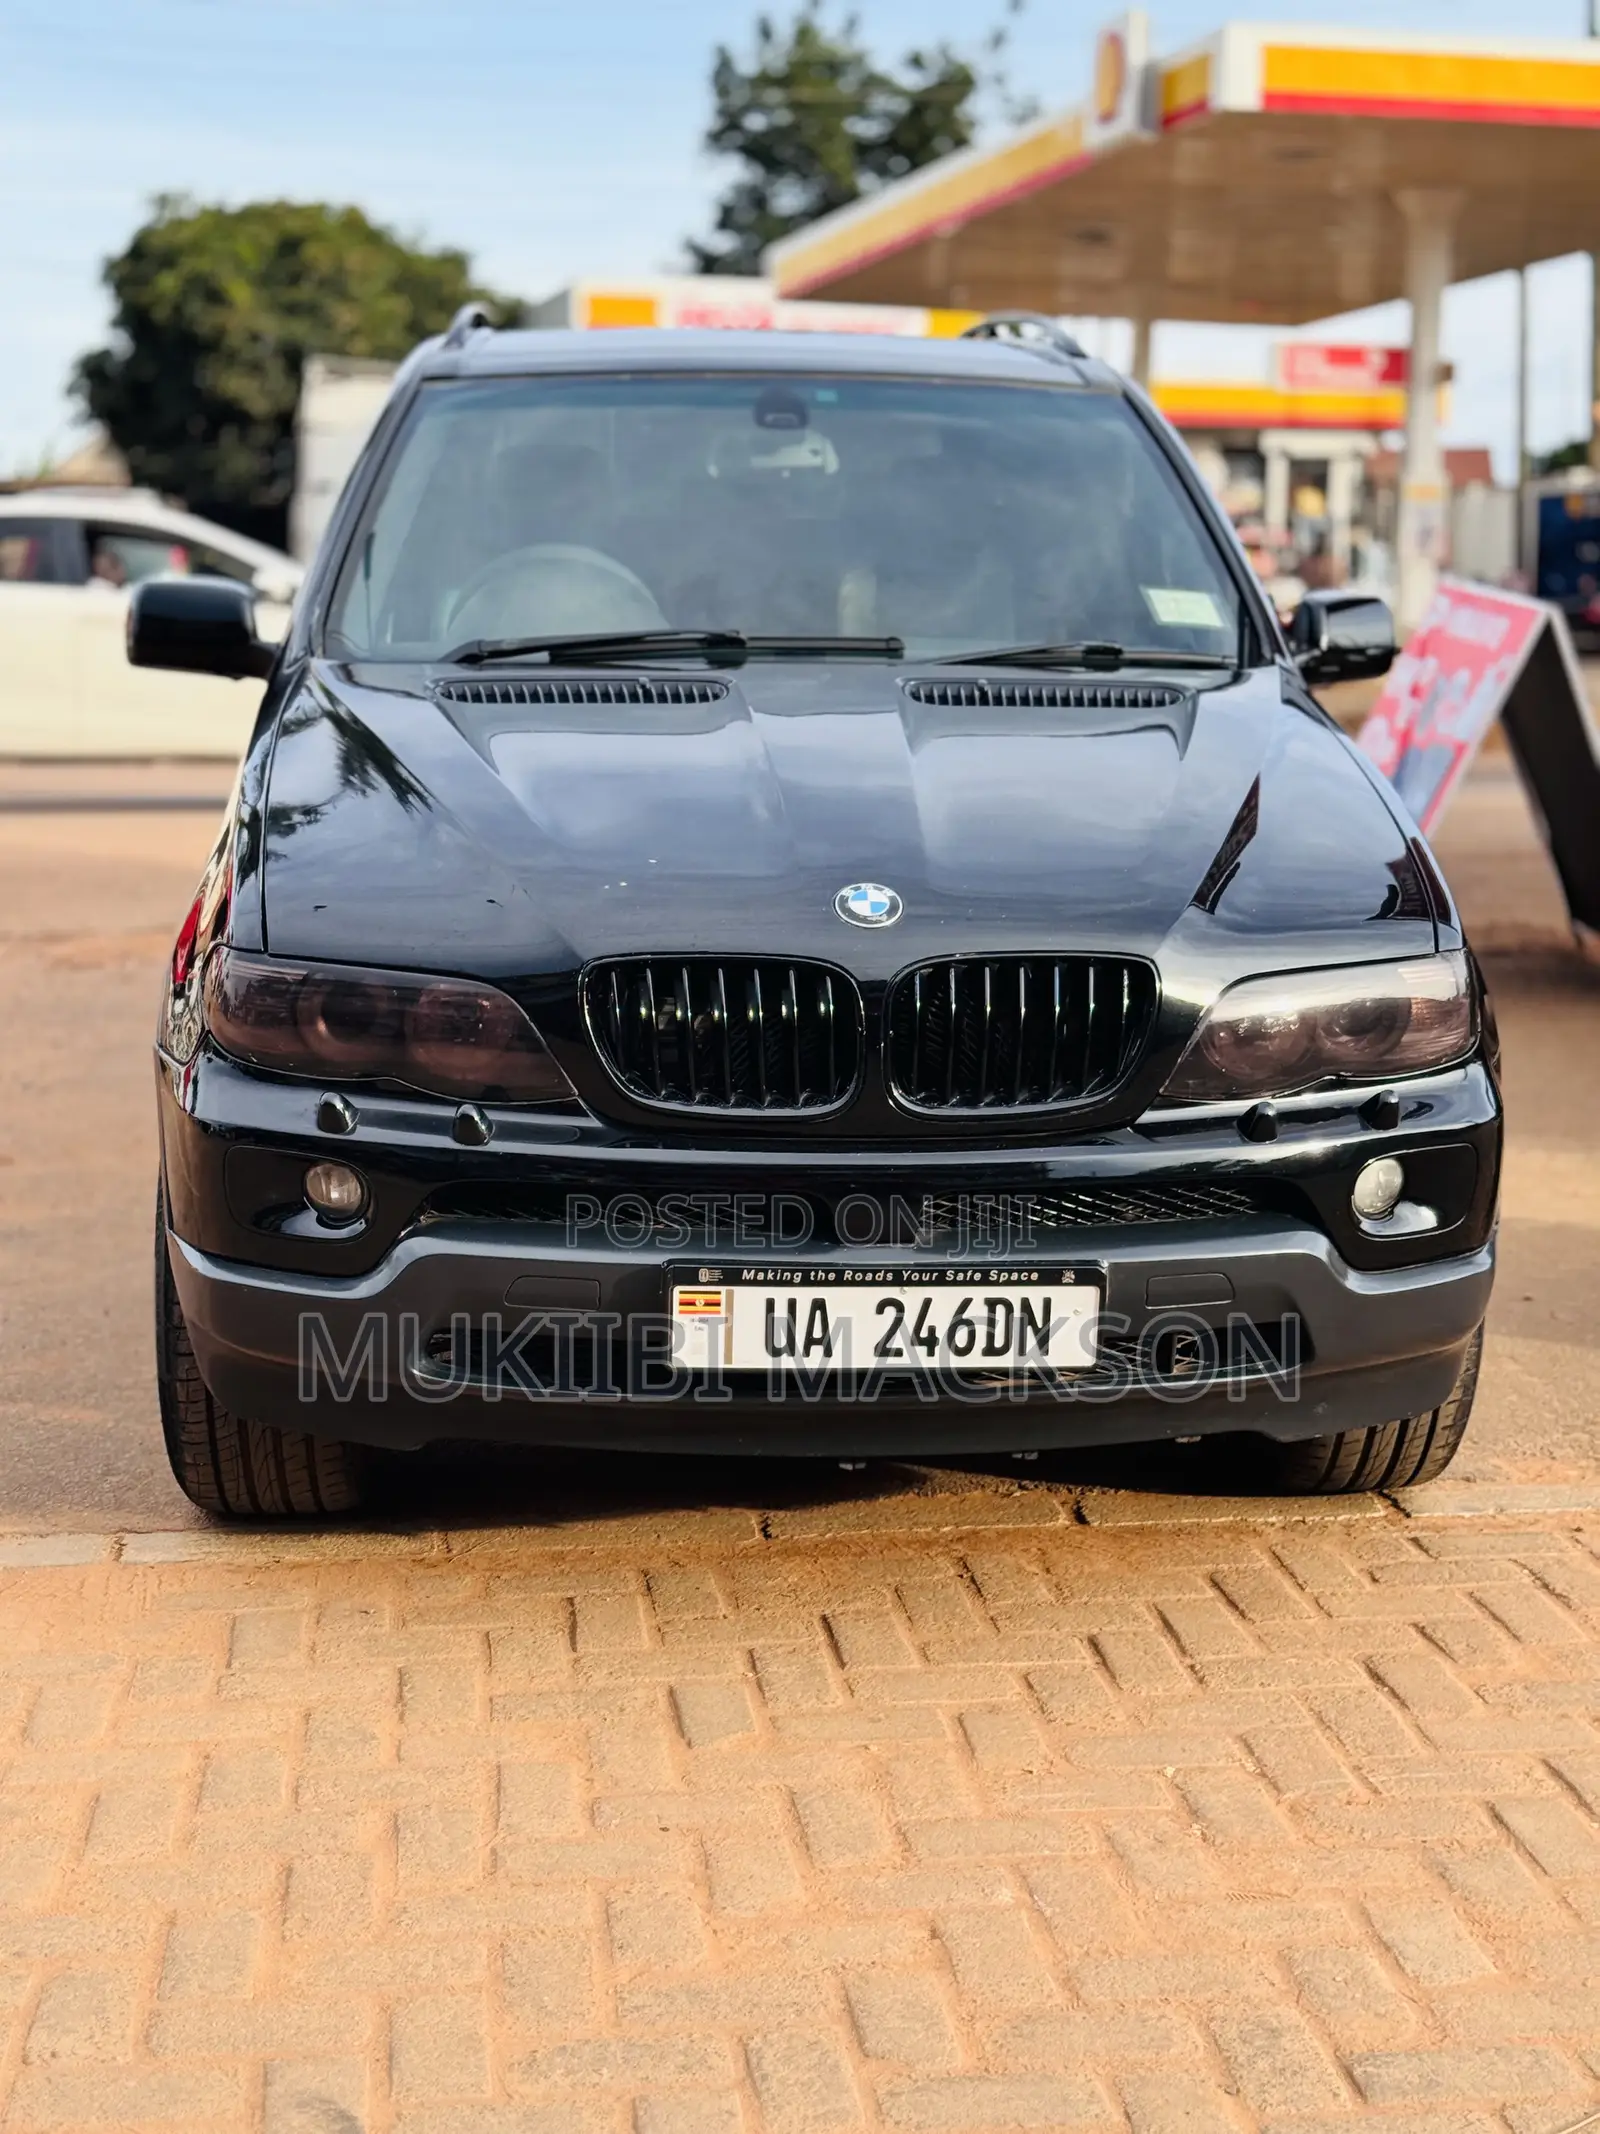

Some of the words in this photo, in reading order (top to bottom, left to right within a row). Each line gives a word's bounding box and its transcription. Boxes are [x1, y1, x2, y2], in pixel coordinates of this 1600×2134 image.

[741, 1269, 803, 1284] Making
[809, 1270, 837, 1281] the
[843, 1270, 894, 1281] Roads
[902, 1270, 939, 1281] Your
[945, 1270, 982, 1281] Safe
[988, 1270, 1039, 1283] Space
[764, 1297, 833, 1358] UA
[873, 1297, 1052, 1357] 246DN
